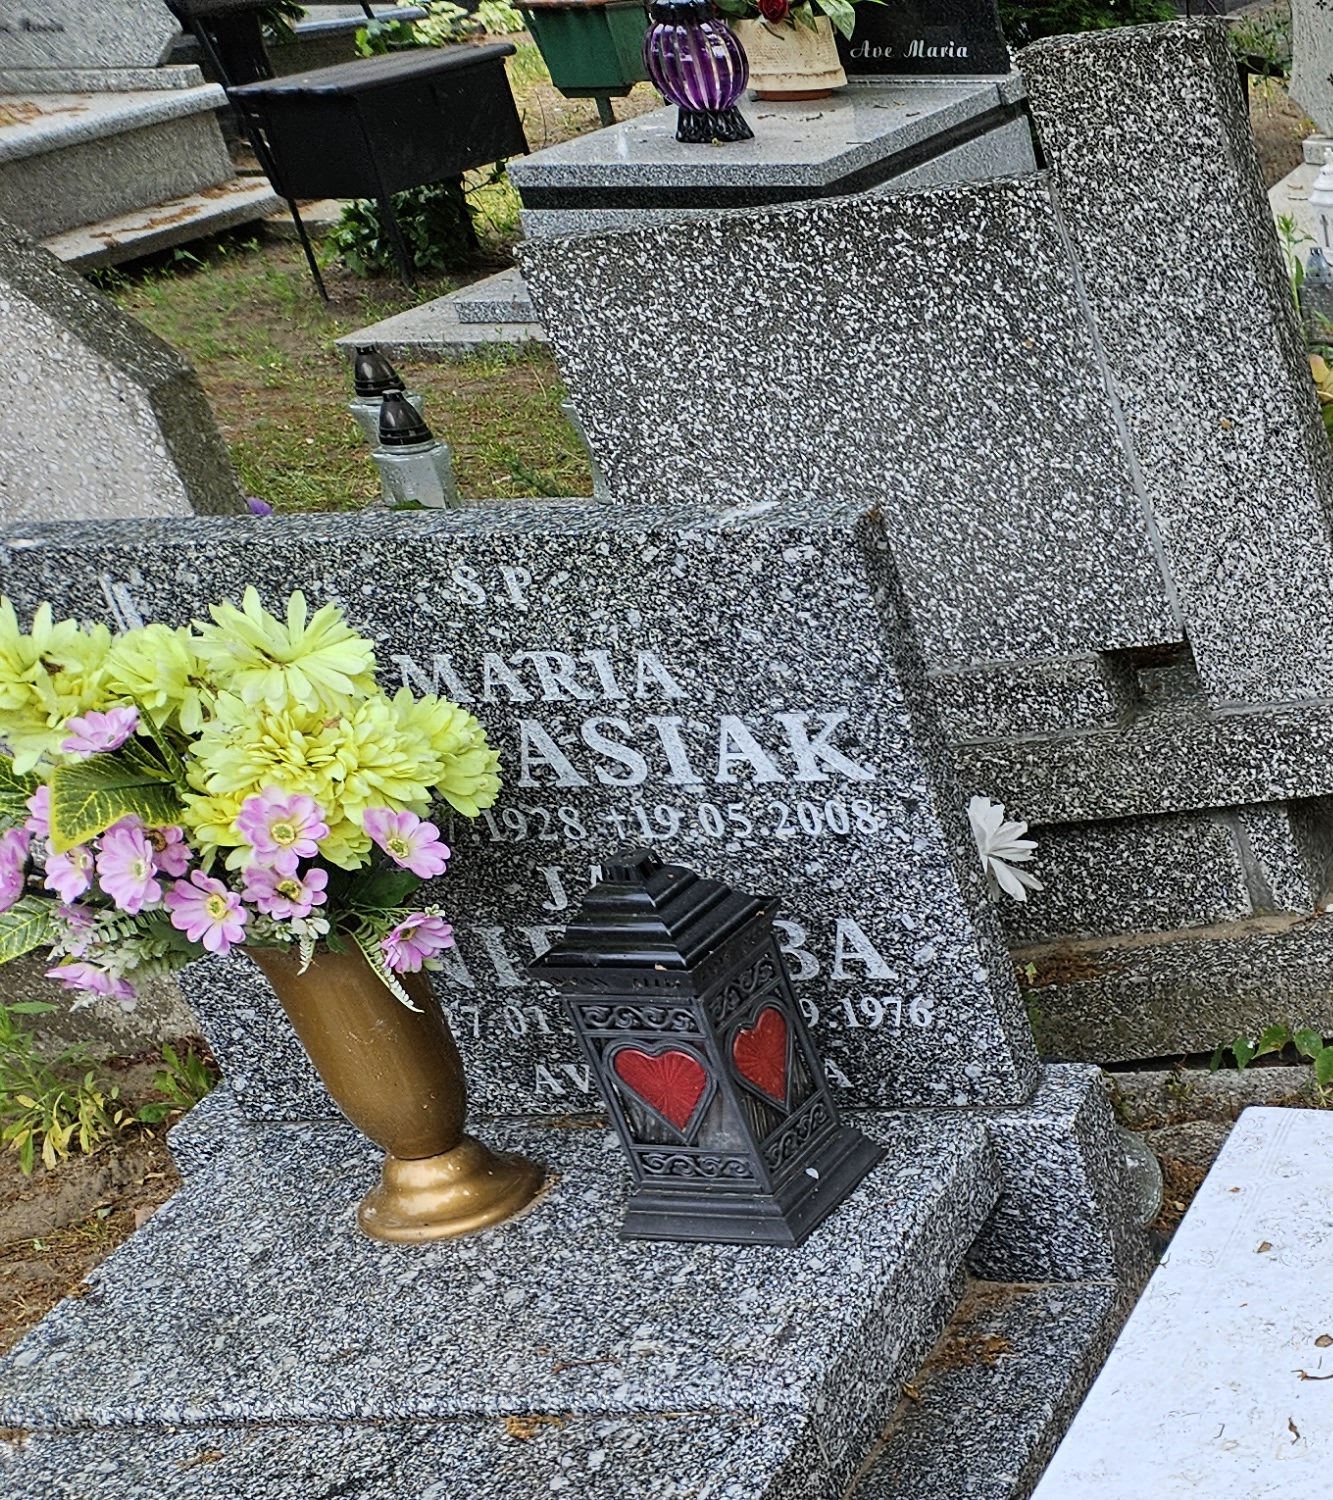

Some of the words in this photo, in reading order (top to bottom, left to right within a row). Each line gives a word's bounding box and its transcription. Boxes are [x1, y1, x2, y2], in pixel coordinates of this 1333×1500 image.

[850, 40, 893, 58] Ave
[903, 39, 969, 58] Maria
[392, 649, 690, 703] MARIA
[517, 710, 878, 788] ASIAK
[633, 799, 880, 841] 19.05.2008
